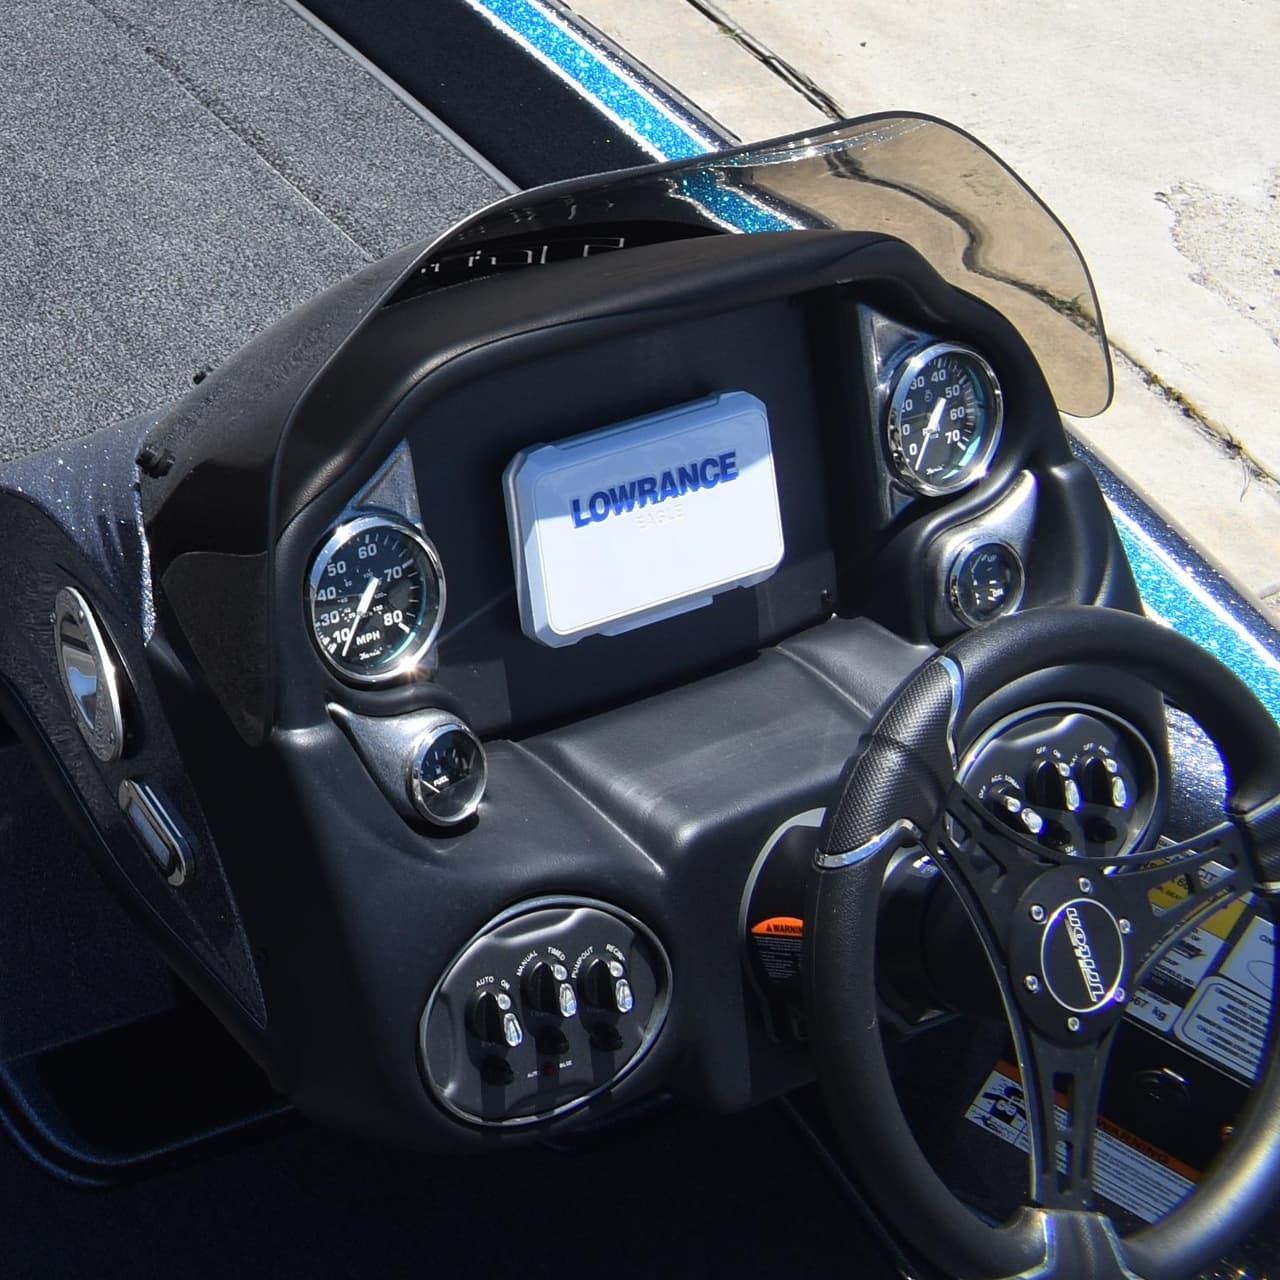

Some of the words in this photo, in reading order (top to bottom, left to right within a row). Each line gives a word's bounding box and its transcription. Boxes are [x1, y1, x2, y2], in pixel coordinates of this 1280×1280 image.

[910, 376, 925, 390] 30
[930, 370, 947, 383] 40
[945, 384, 960, 399] 50
[950, 406, 965, 421] 60
[945, 429, 961, 444] 70
[909, 443, 918, 456] 0
[571, 449, 740, 529] LOWRANCE
[358, 543, 377, 559] 60
[327, 561, 347, 577] 50
[384, 566, 402, 582] 70
[318, 586, 336, 601] 40
[320, 610, 340, 626] 30
[383, 610, 403, 626] 80
[333, 627, 351, 644] 10
[356, 630, 381, 646] MPH
[516, 950, 539, 977] MANUAL
[547, 946, 566, 961] TIMED
[571, 946, 593, 979] PUMPOUT
[476, 976, 495, 988] AUTO
[500, 980, 511, 990] ON
